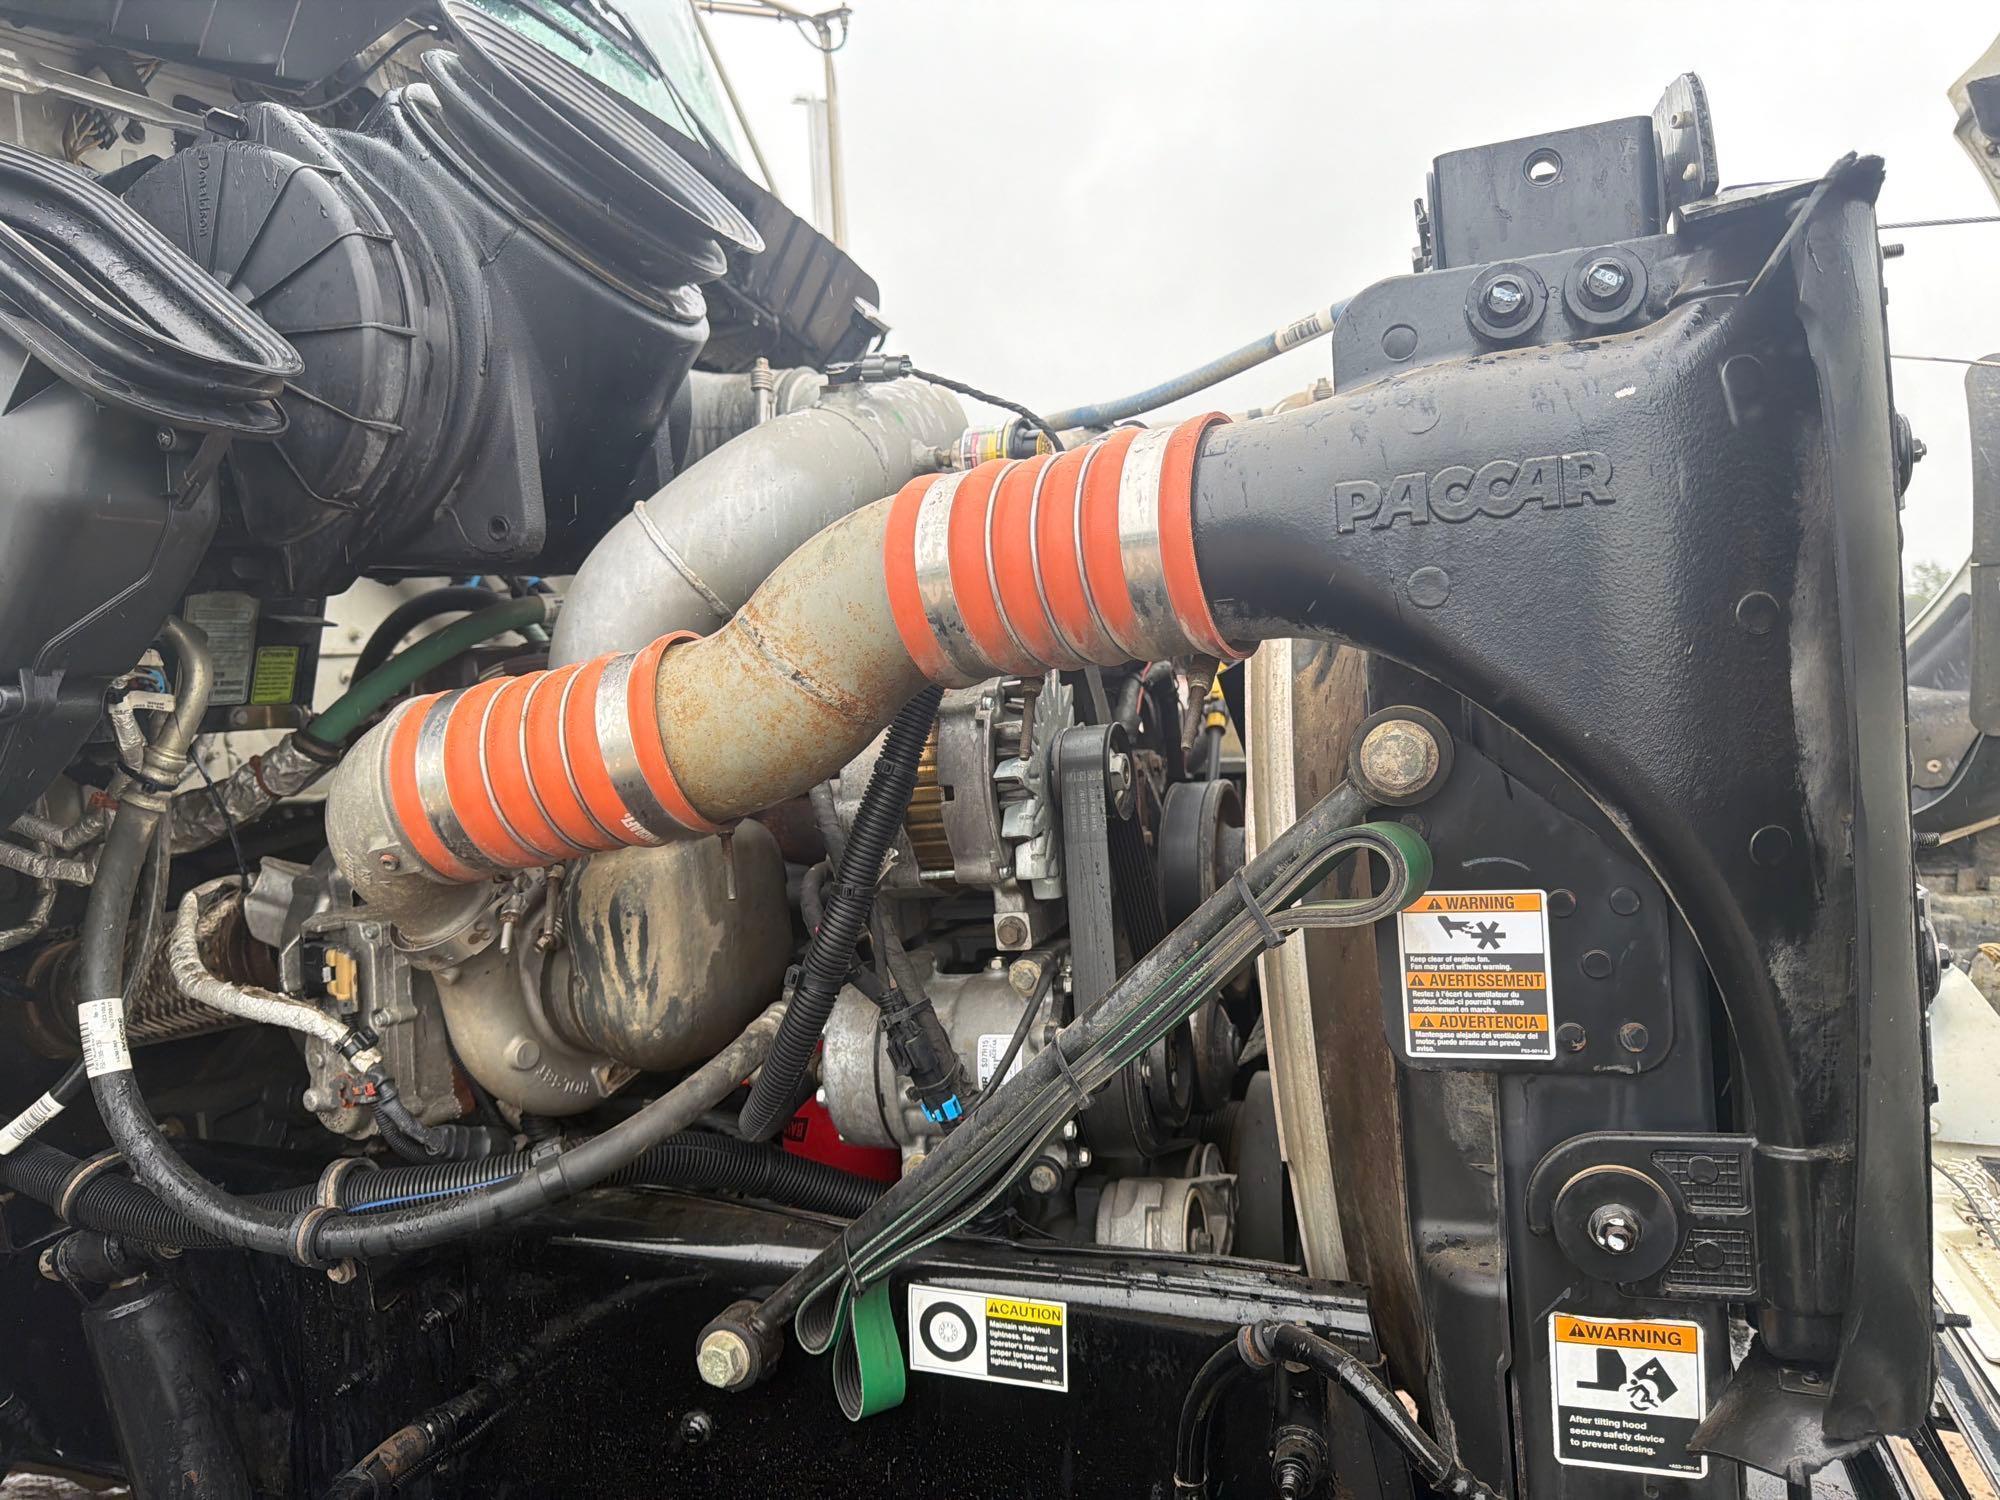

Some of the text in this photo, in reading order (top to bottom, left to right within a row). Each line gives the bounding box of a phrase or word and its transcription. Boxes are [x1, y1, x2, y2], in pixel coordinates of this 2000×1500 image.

[1334, 451, 1616, 533] PACCAR
[1445, 896, 1515, 910] WARNING
[1410, 956, 1426, 964] Keep
[1454, 956, 1476, 964] engine
[1430, 974, 1542, 987] AVERTISSEMENT
[1440, 1016, 1539, 1029] ADVERTENCIA
[1415, 1031, 1454, 1039] Mantengase
[1000, 1304, 1060, 1321] CAUTION
[990, 1320, 1017, 1330] Maintain
[990, 1330, 1035, 1342] tightness. See
[1586, 1325, 1682, 1346] WARNING
[990, 1339, 1059, 1354] operator's manual for
[990, 1349, 1011, 1357] proper
[1013, 1351, 1034, 1360] torque
[991, 1357, 1057, 1373] tightening sequence.
[1569, 1415, 1647, 1430] After tilting hood
[1570, 1427, 1665, 1444] secure safety device
[1570, 1438, 1656, 1455] to prevent closing.
